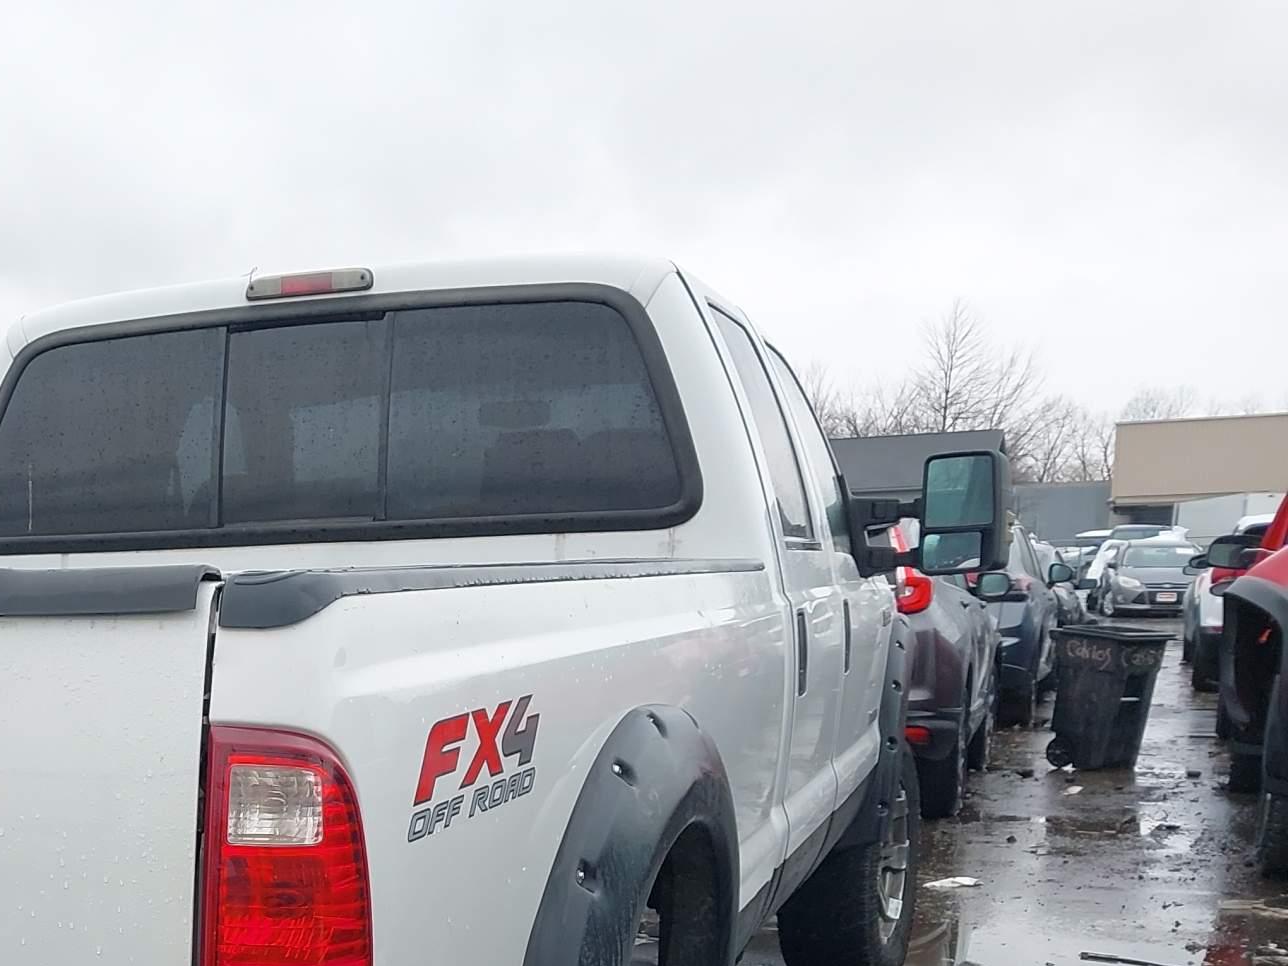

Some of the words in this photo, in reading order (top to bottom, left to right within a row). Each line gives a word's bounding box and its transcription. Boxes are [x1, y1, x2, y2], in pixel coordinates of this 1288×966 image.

[413, 694, 541, 806] FX4
[407, 796, 464, 843] OFF
[468, 766, 537, 819] ROAD
